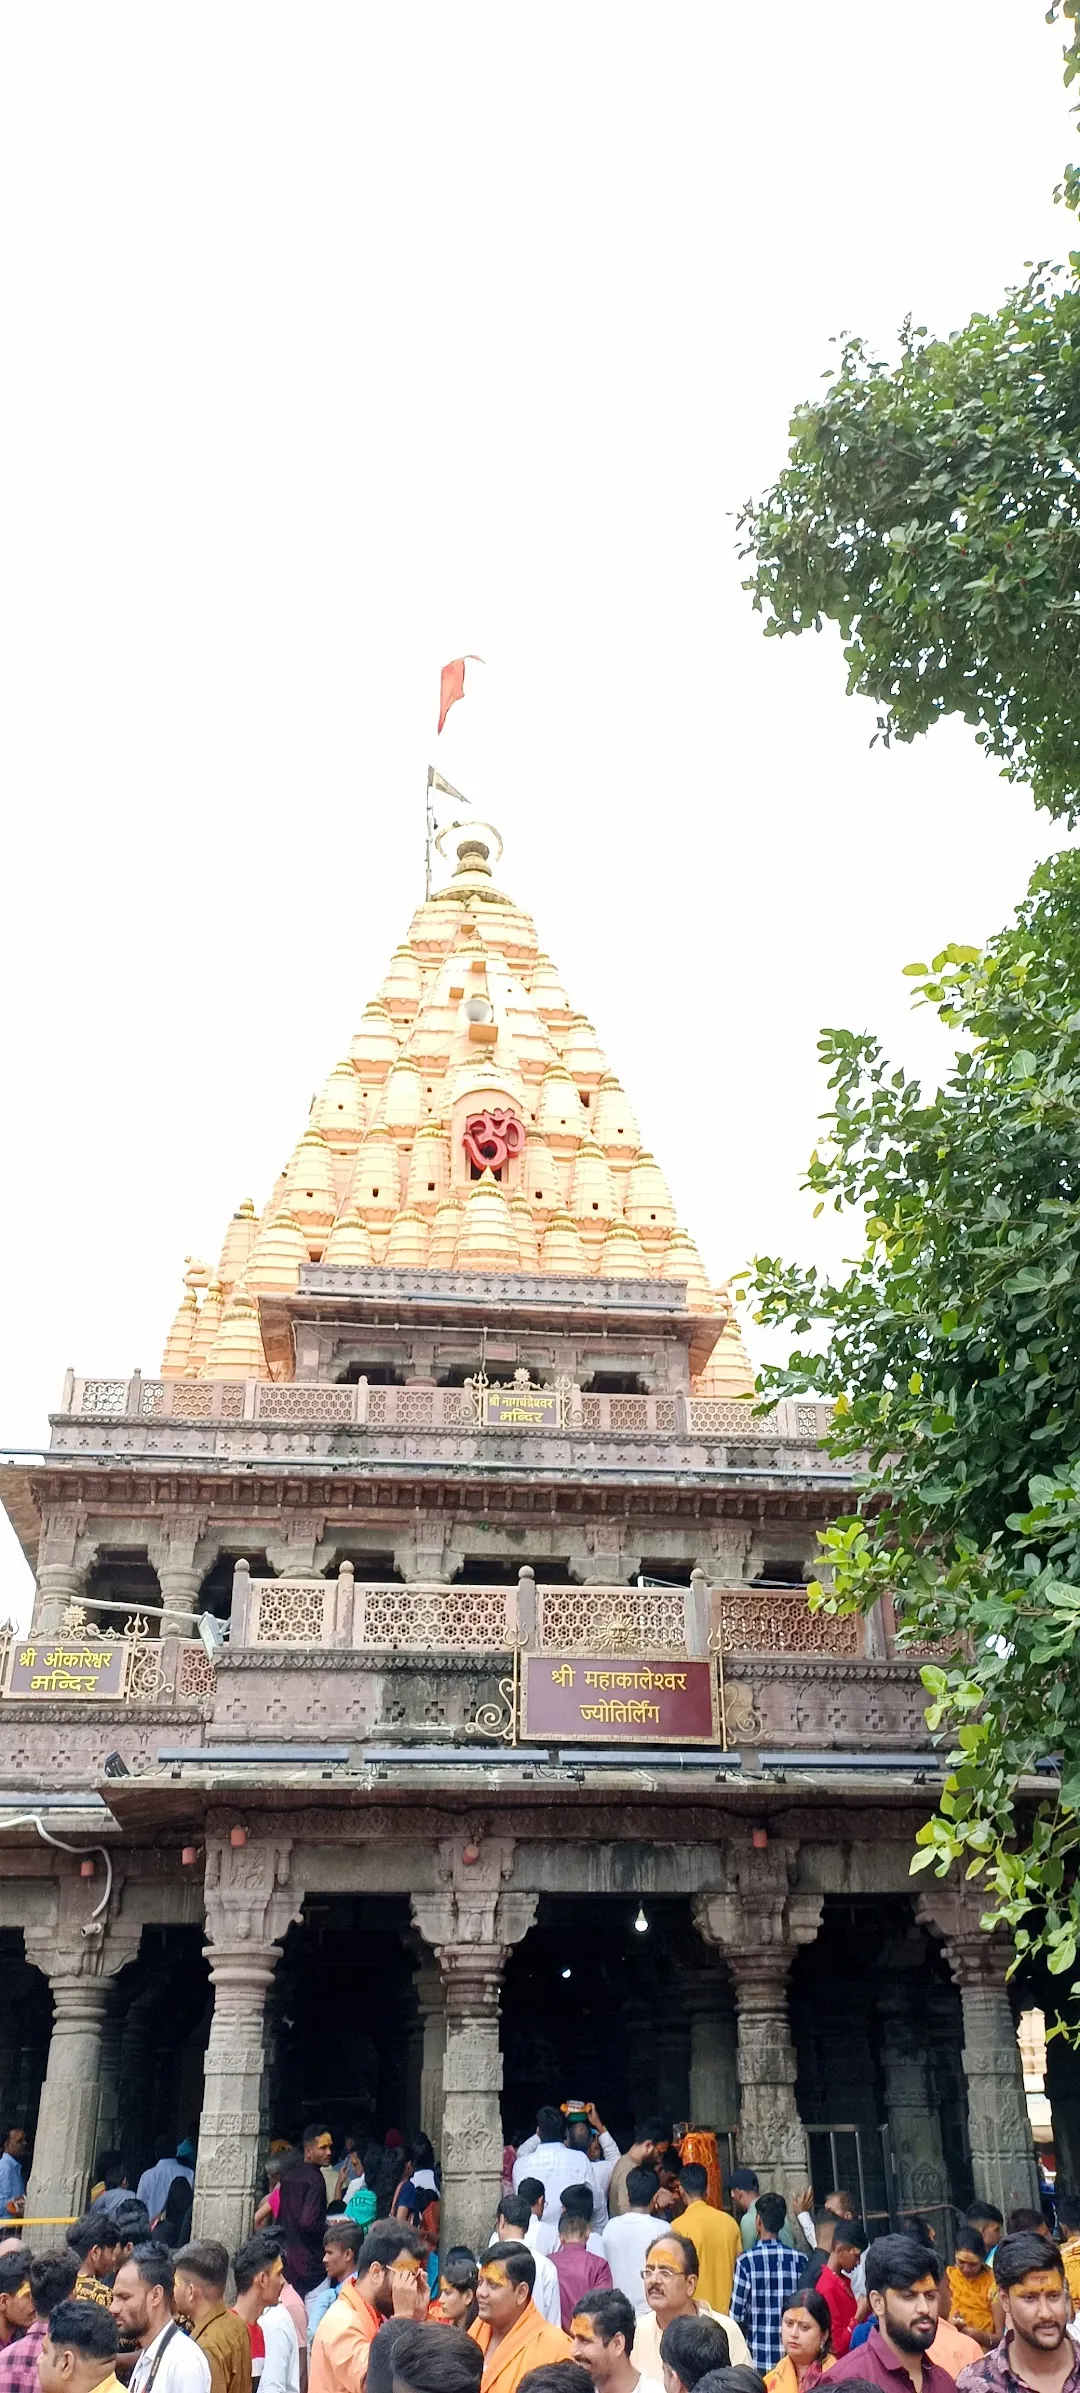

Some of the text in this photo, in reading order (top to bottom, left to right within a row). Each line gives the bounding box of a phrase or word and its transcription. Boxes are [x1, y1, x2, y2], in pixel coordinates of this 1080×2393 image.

[488, 1394, 501, 1407] श्री
[500, 1408, 544, 1422] मन्दिर
[19, 1647, 113, 1669] श्री ओंकारेश्वर
[30, 1669, 99, 1691] मन्दिर
[551, 1663, 687, 1691] श्री महाकालेश्वर
[579, 1699, 660, 1724] ज्योतिर्लिंग
